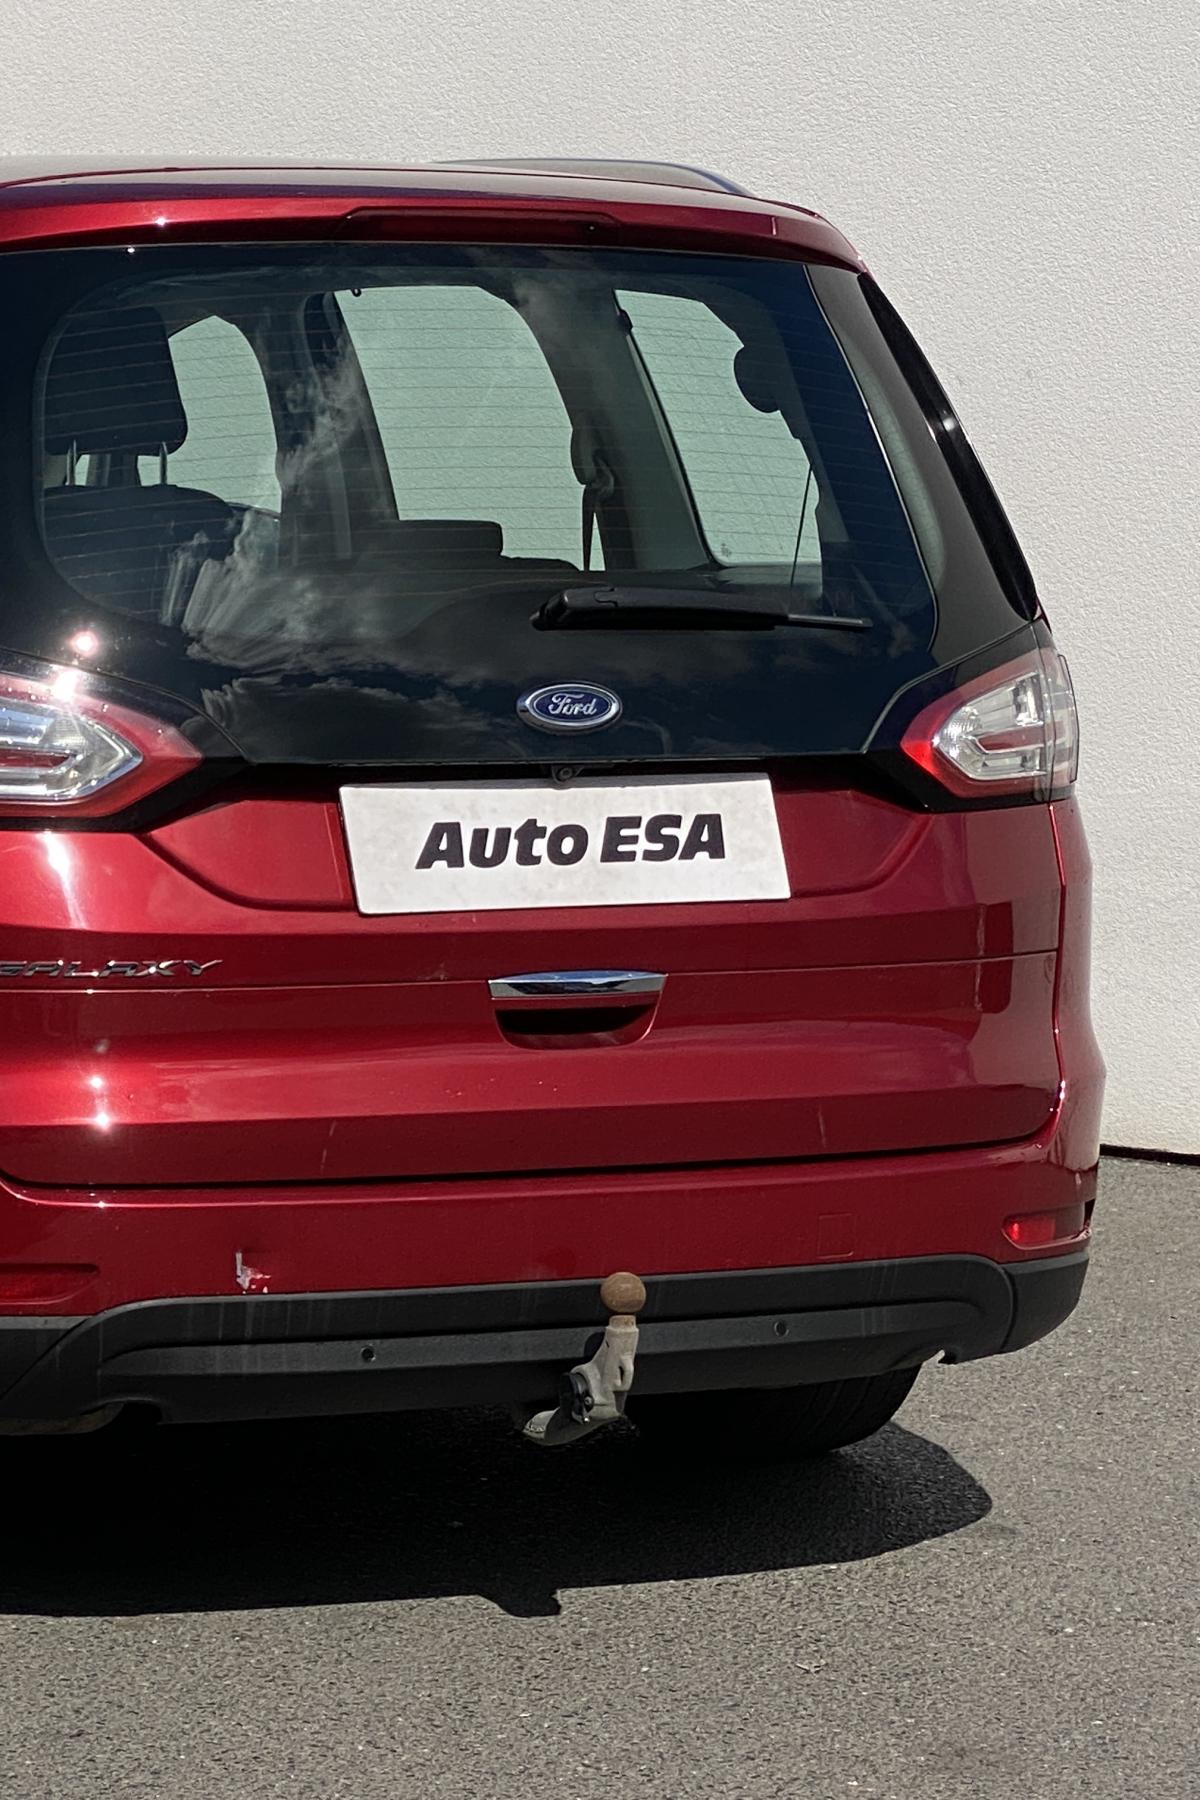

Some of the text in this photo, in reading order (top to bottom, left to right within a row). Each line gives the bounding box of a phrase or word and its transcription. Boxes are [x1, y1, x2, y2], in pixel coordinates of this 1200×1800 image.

[548, 693, 597, 715] Ford
[415, 813, 726, 869] Auto ESA
